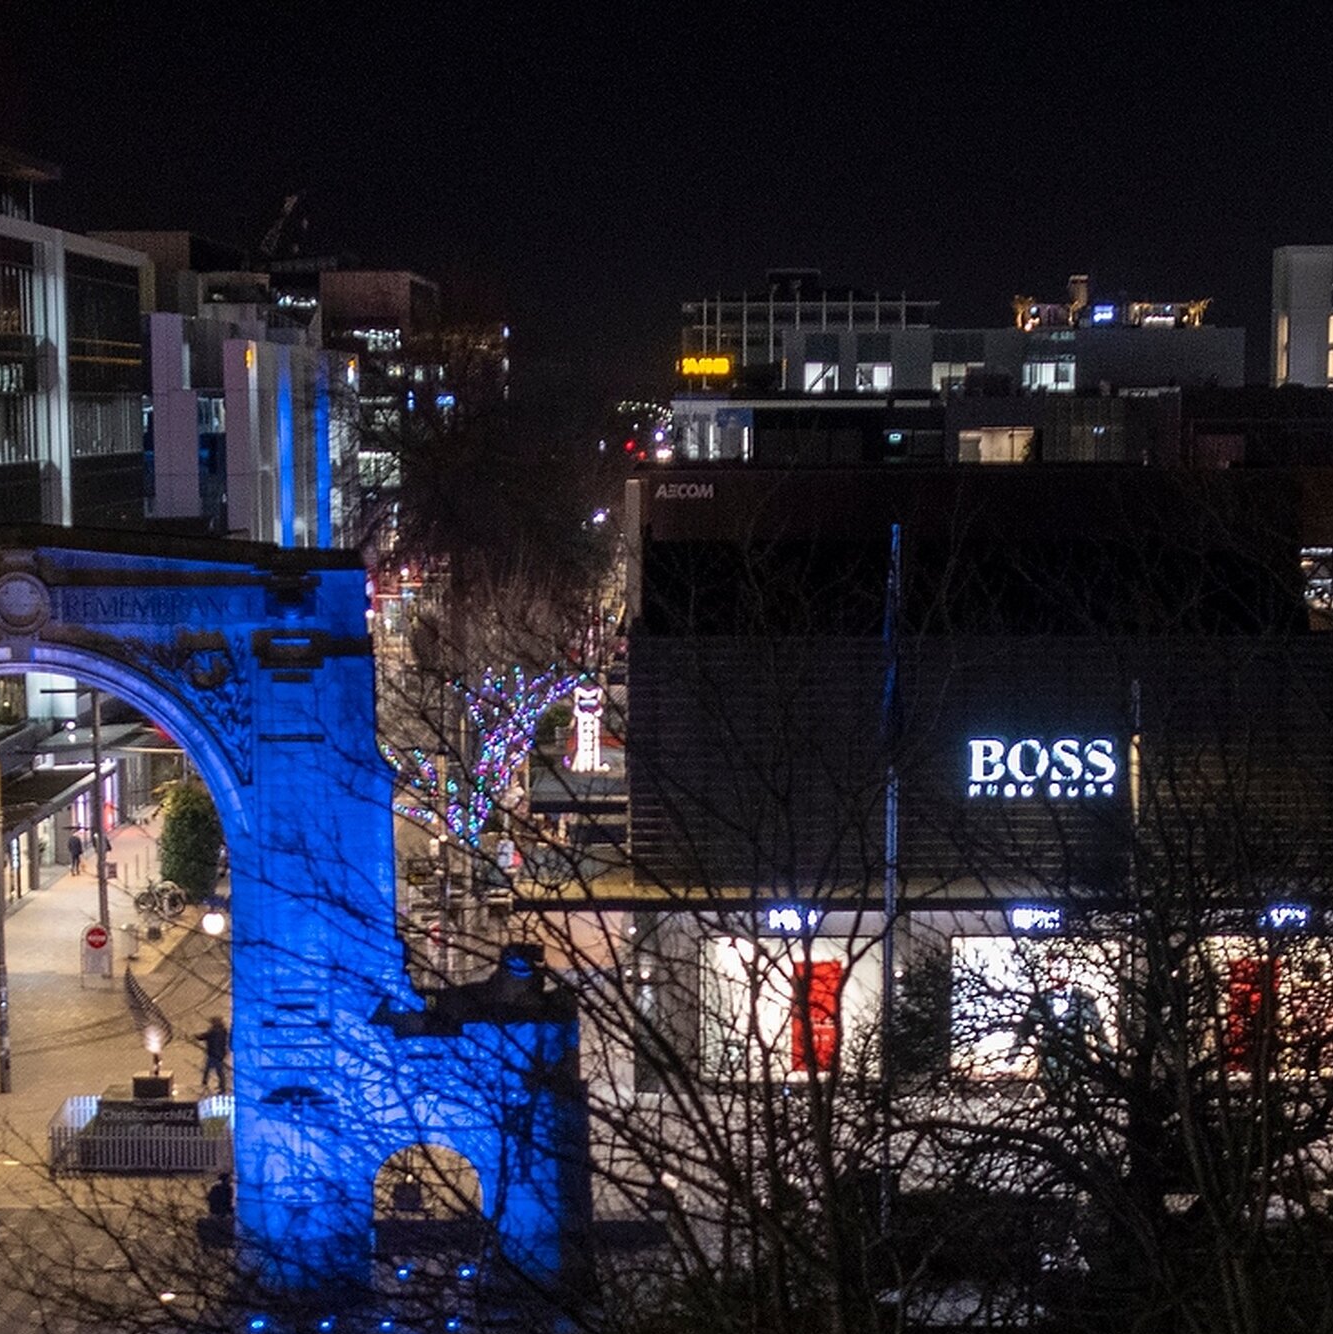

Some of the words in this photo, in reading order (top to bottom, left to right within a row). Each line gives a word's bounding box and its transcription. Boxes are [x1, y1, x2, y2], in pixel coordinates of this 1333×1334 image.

[655, 483, 715, 499] AECOM
[64, 592, 256, 618] REMEMBRANCE
[967, 738, 1116, 782] BOSS
